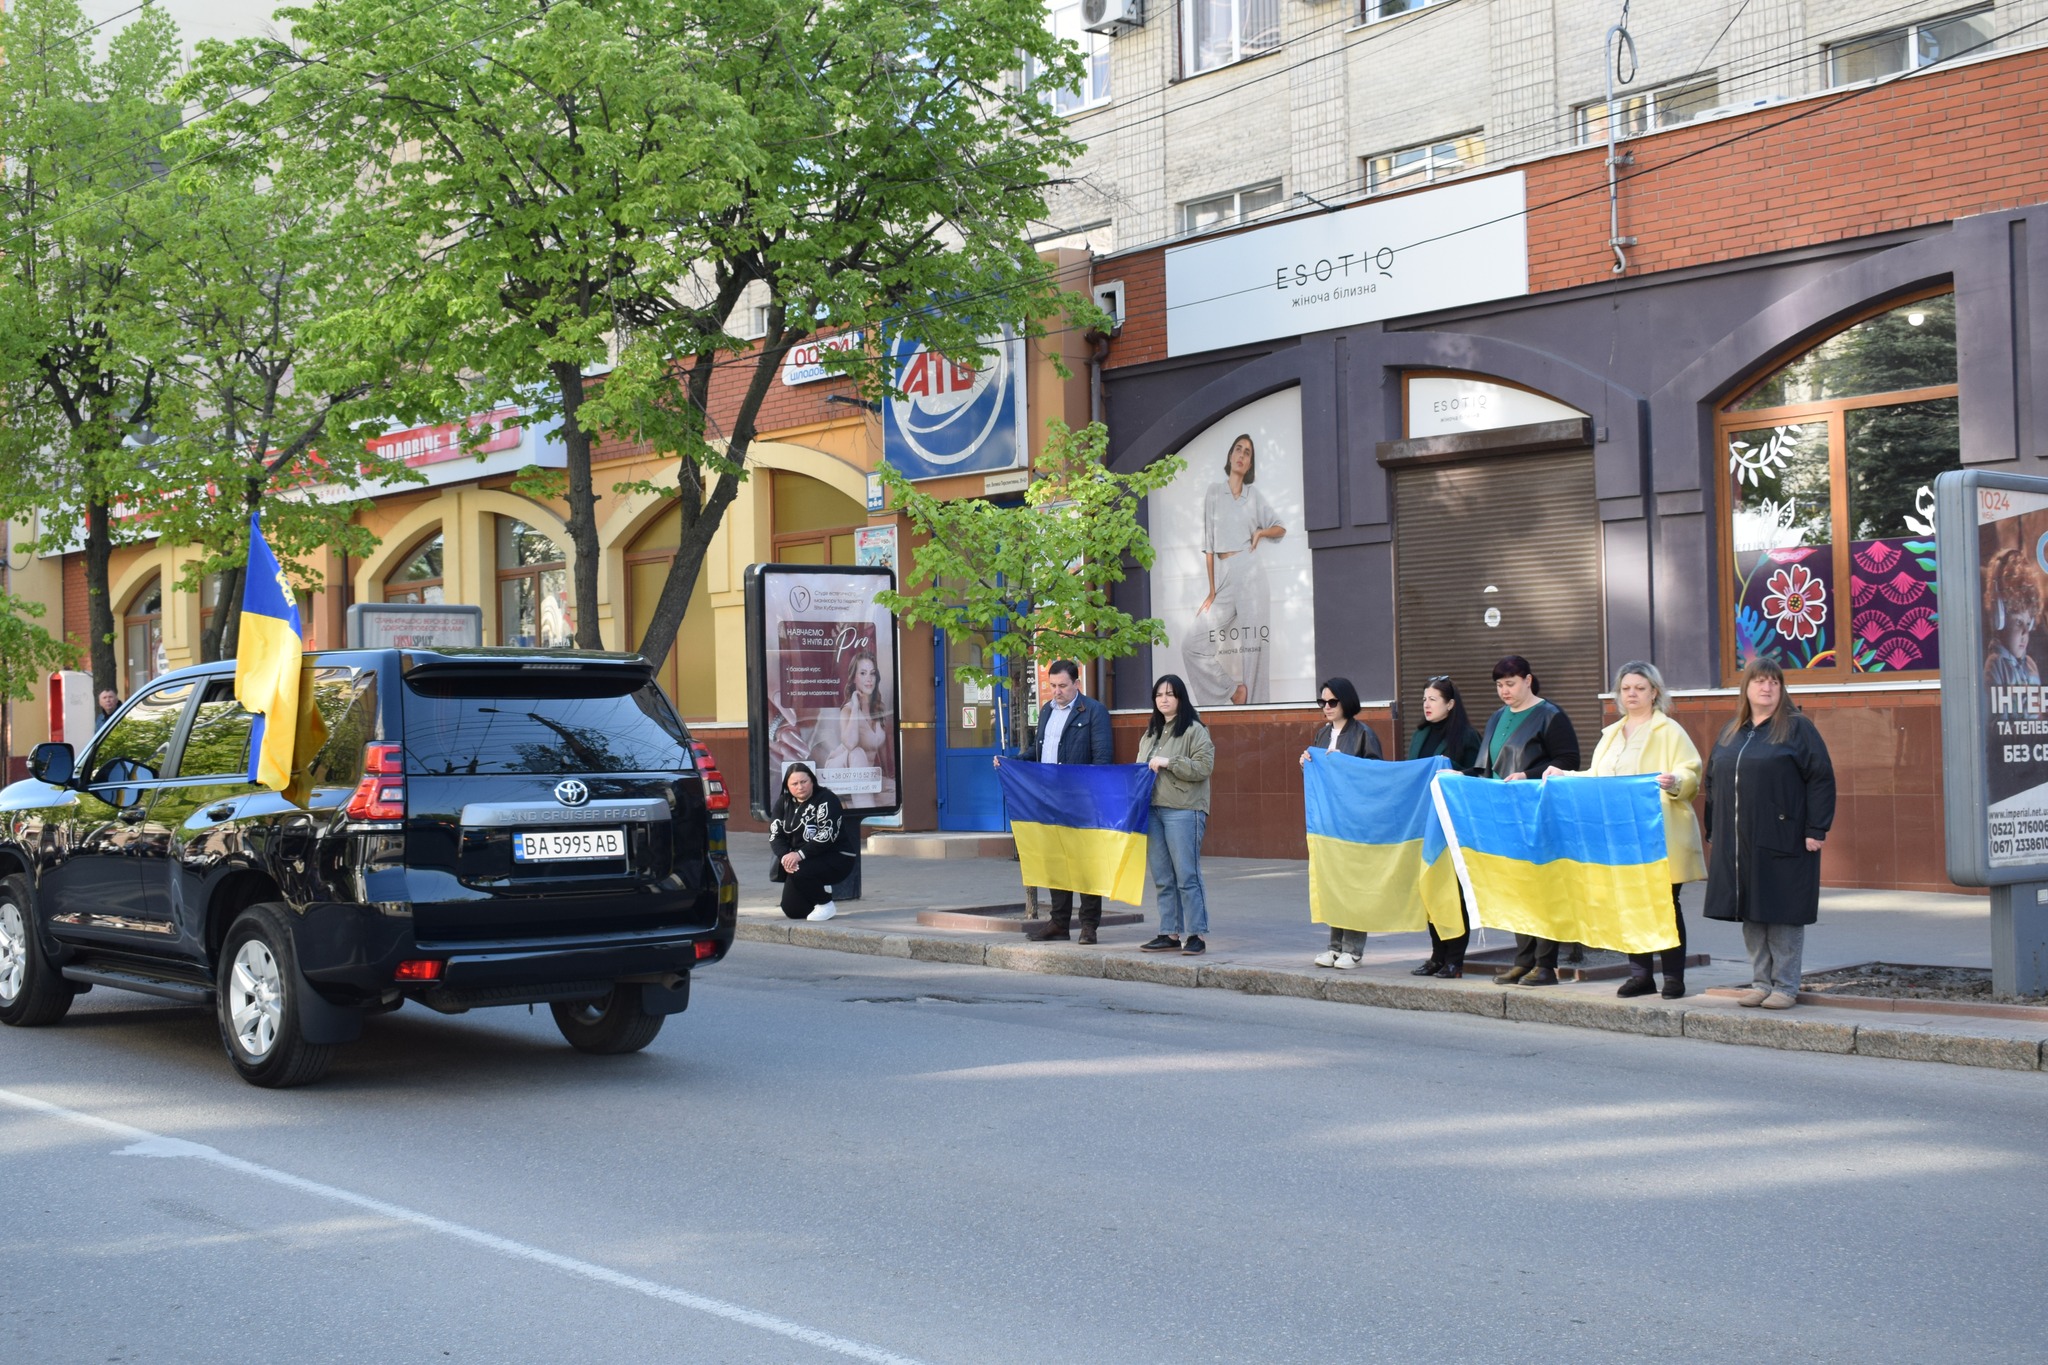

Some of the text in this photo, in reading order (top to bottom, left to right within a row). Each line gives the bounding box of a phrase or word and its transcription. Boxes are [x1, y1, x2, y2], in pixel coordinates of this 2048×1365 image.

[1276, 247, 1394, 290] ESOTIQ
[1291, 283, 1377, 308] жіноча білизна
[1433, 395, 1487, 413] ESOTIQ
[1980, 490, 2010, 511] 1024
[786, 628, 825, 637] НАВЧАЄМО
[1209, 625, 1270, 643] ESOTIQ
[823, 638, 834, 647] ДО
[835, 626, 869, 663] Pro
[1997, 720, 2048, 736] ТА ТЕЛЕБ
[2003, 744, 2031, 763] БЕЗ
[499, 807, 647, 823] LAND CRUISER PRADO
[1989, 821, 2016, 840] (0522)
[525, 834, 618, 856] BA 5995 AB
[1990, 839, 2014, 857] (067)
